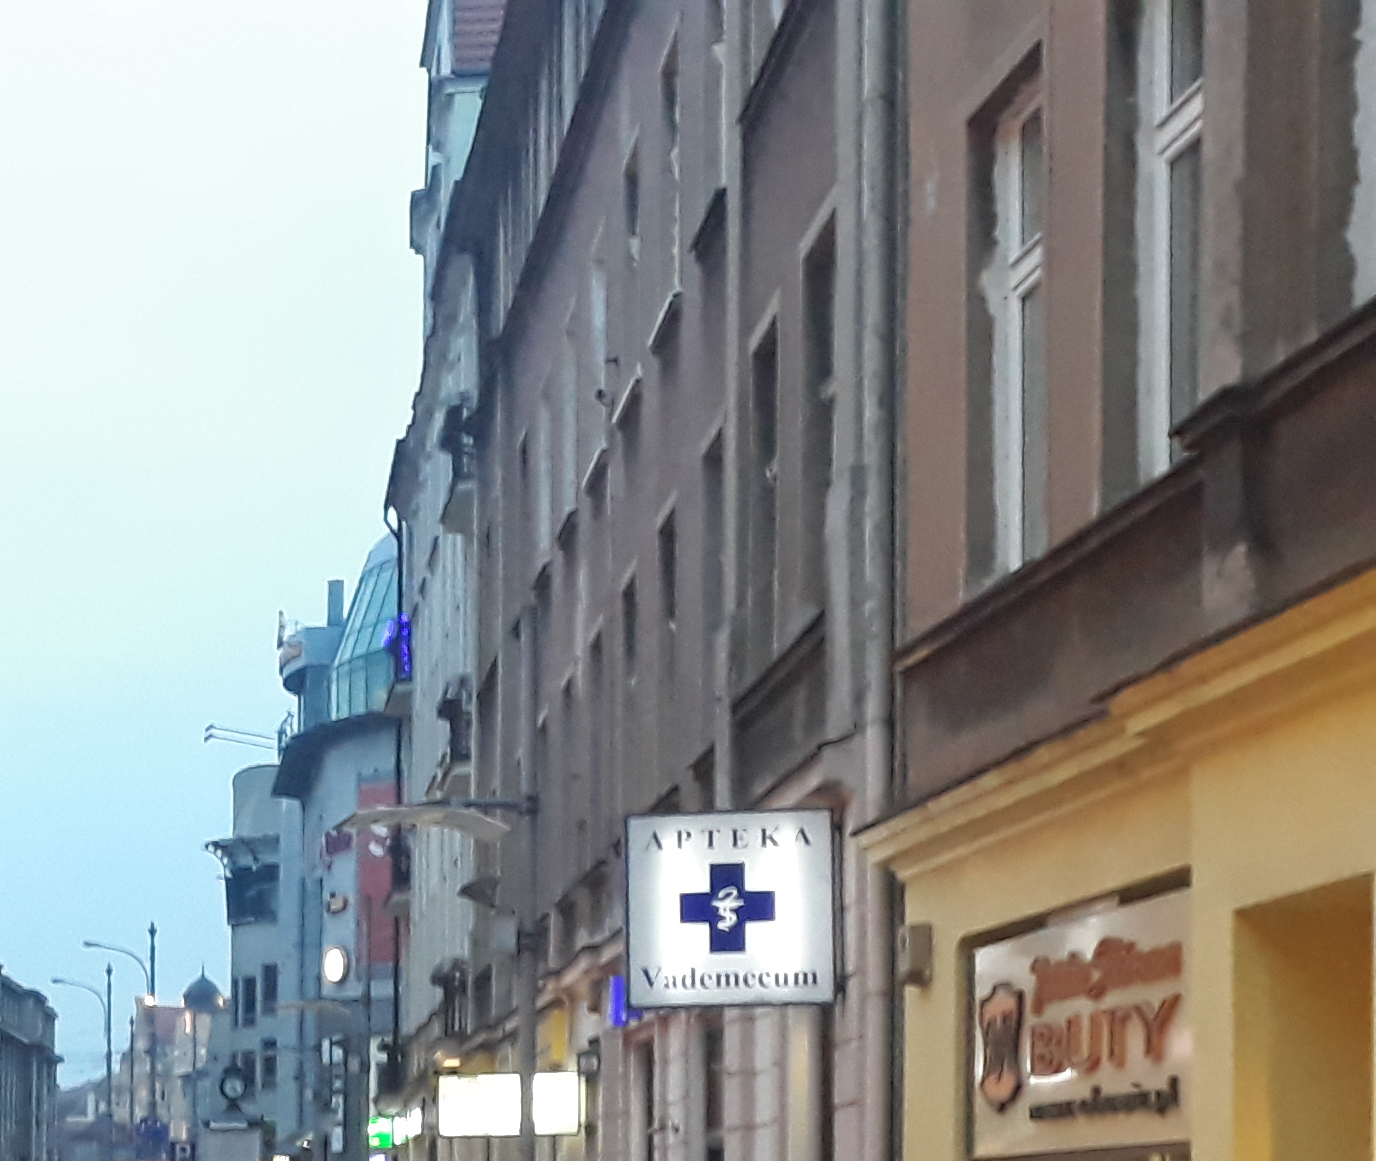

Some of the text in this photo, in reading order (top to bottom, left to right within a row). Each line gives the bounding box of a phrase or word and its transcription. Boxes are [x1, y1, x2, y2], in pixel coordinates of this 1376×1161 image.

[644, 826, 813, 852] APTEKA
[641, 965, 821, 991] Vademecum
[1030, 993, 1182, 1076] BUTY
